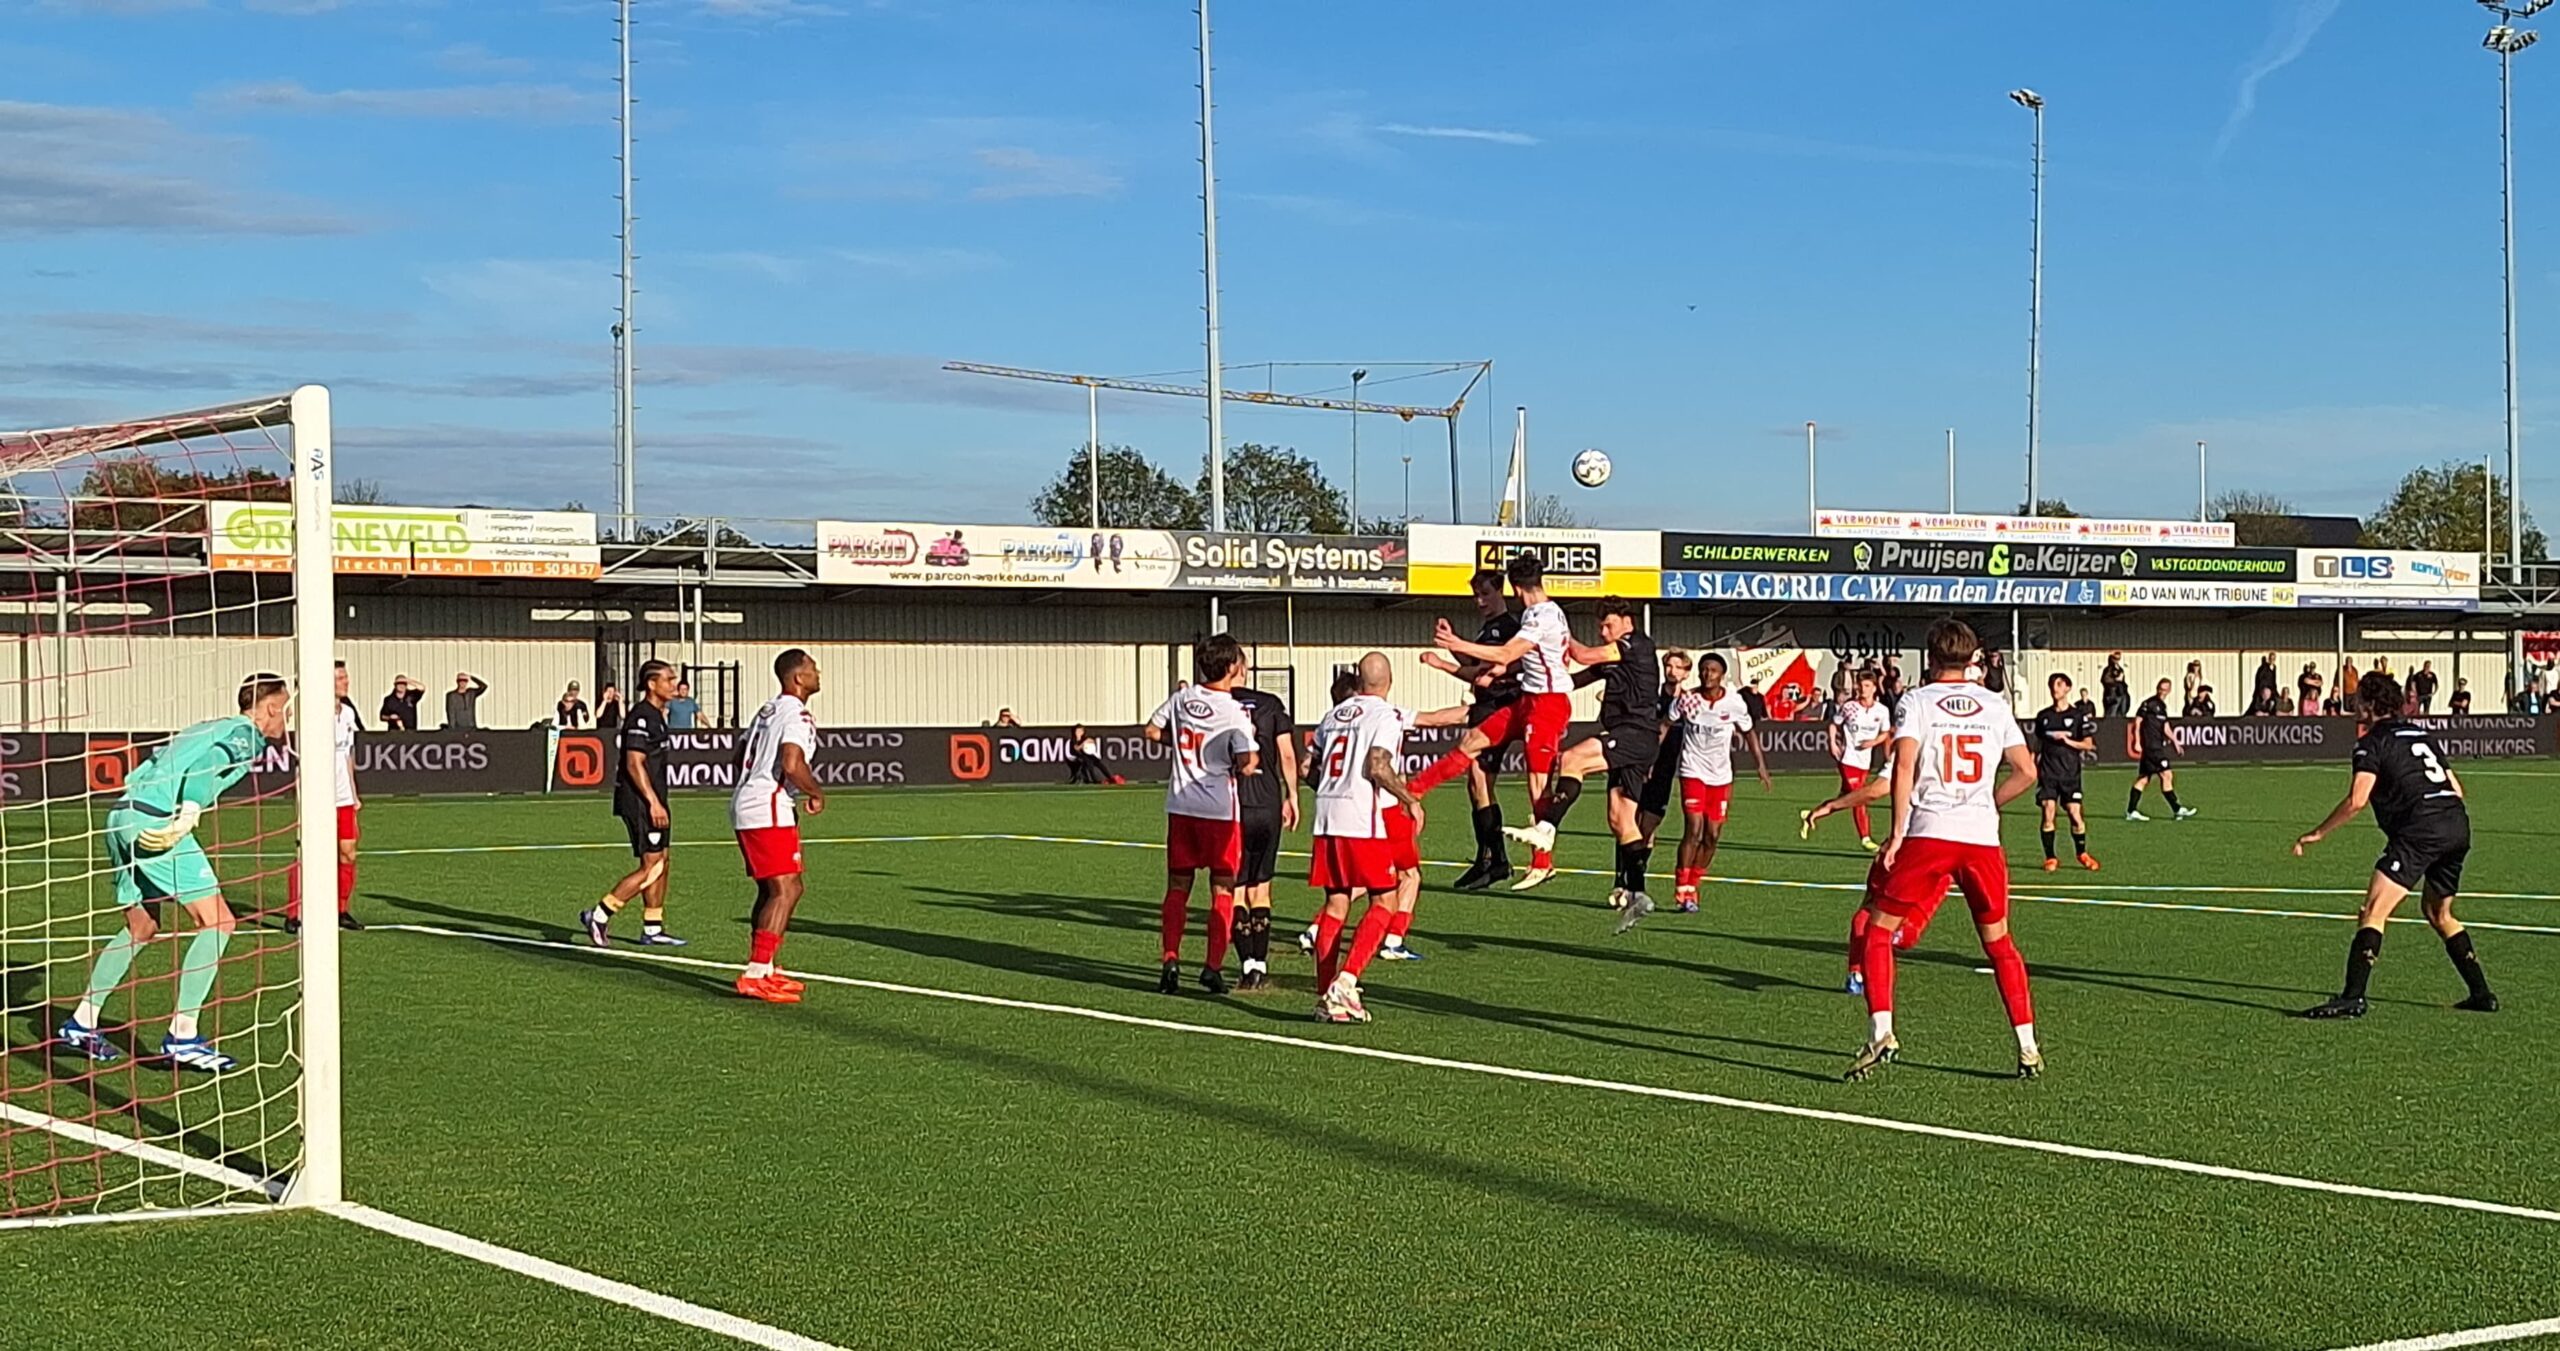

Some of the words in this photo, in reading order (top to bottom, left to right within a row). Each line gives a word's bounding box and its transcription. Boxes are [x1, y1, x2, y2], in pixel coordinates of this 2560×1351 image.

[226, 509, 471, 553] GRNEVELD
[827, 534, 907, 560] PARCON
[1001, 539, 1075, 563] PARCON
[1187, 537, 1257, 569] Solid
[1266, 538, 1383, 576] Systems
[1481, 545, 1597, 573] 4FURES
[1682, 544, 1830, 563] SCHILDERWERKEN
[1880, 541, 1984, 573] Pruijsen
[1988, 544, 2009, 575] &
[889, 571, 1065, 583] www.parcon-werkendam.nl
[2151, 558, 2285, 573] VASTGOEDONDERHOUD
[2314, 555, 2393, 578] TLS
[1698, 572, 1832, 600] SLAGERIJ
[1841, 576, 1896, 601] C.W.
[1904, 583, 1942, 602] van
[1948, 577, 1988, 603] den
[1993, 579, 2068, 604] Heuvel
[2130, 587, 2148, 600] AD
[2152, 588, 2176, 600] VAN
[2180, 588, 2210, 601] WIJK
[2215, 588, 2268, 602] TRIBUNE
[1746, 641, 1793, 670] KOZAKKEN
[1941, 734, 1983, 783] 15
[2411, 743, 2447, 782] 3
